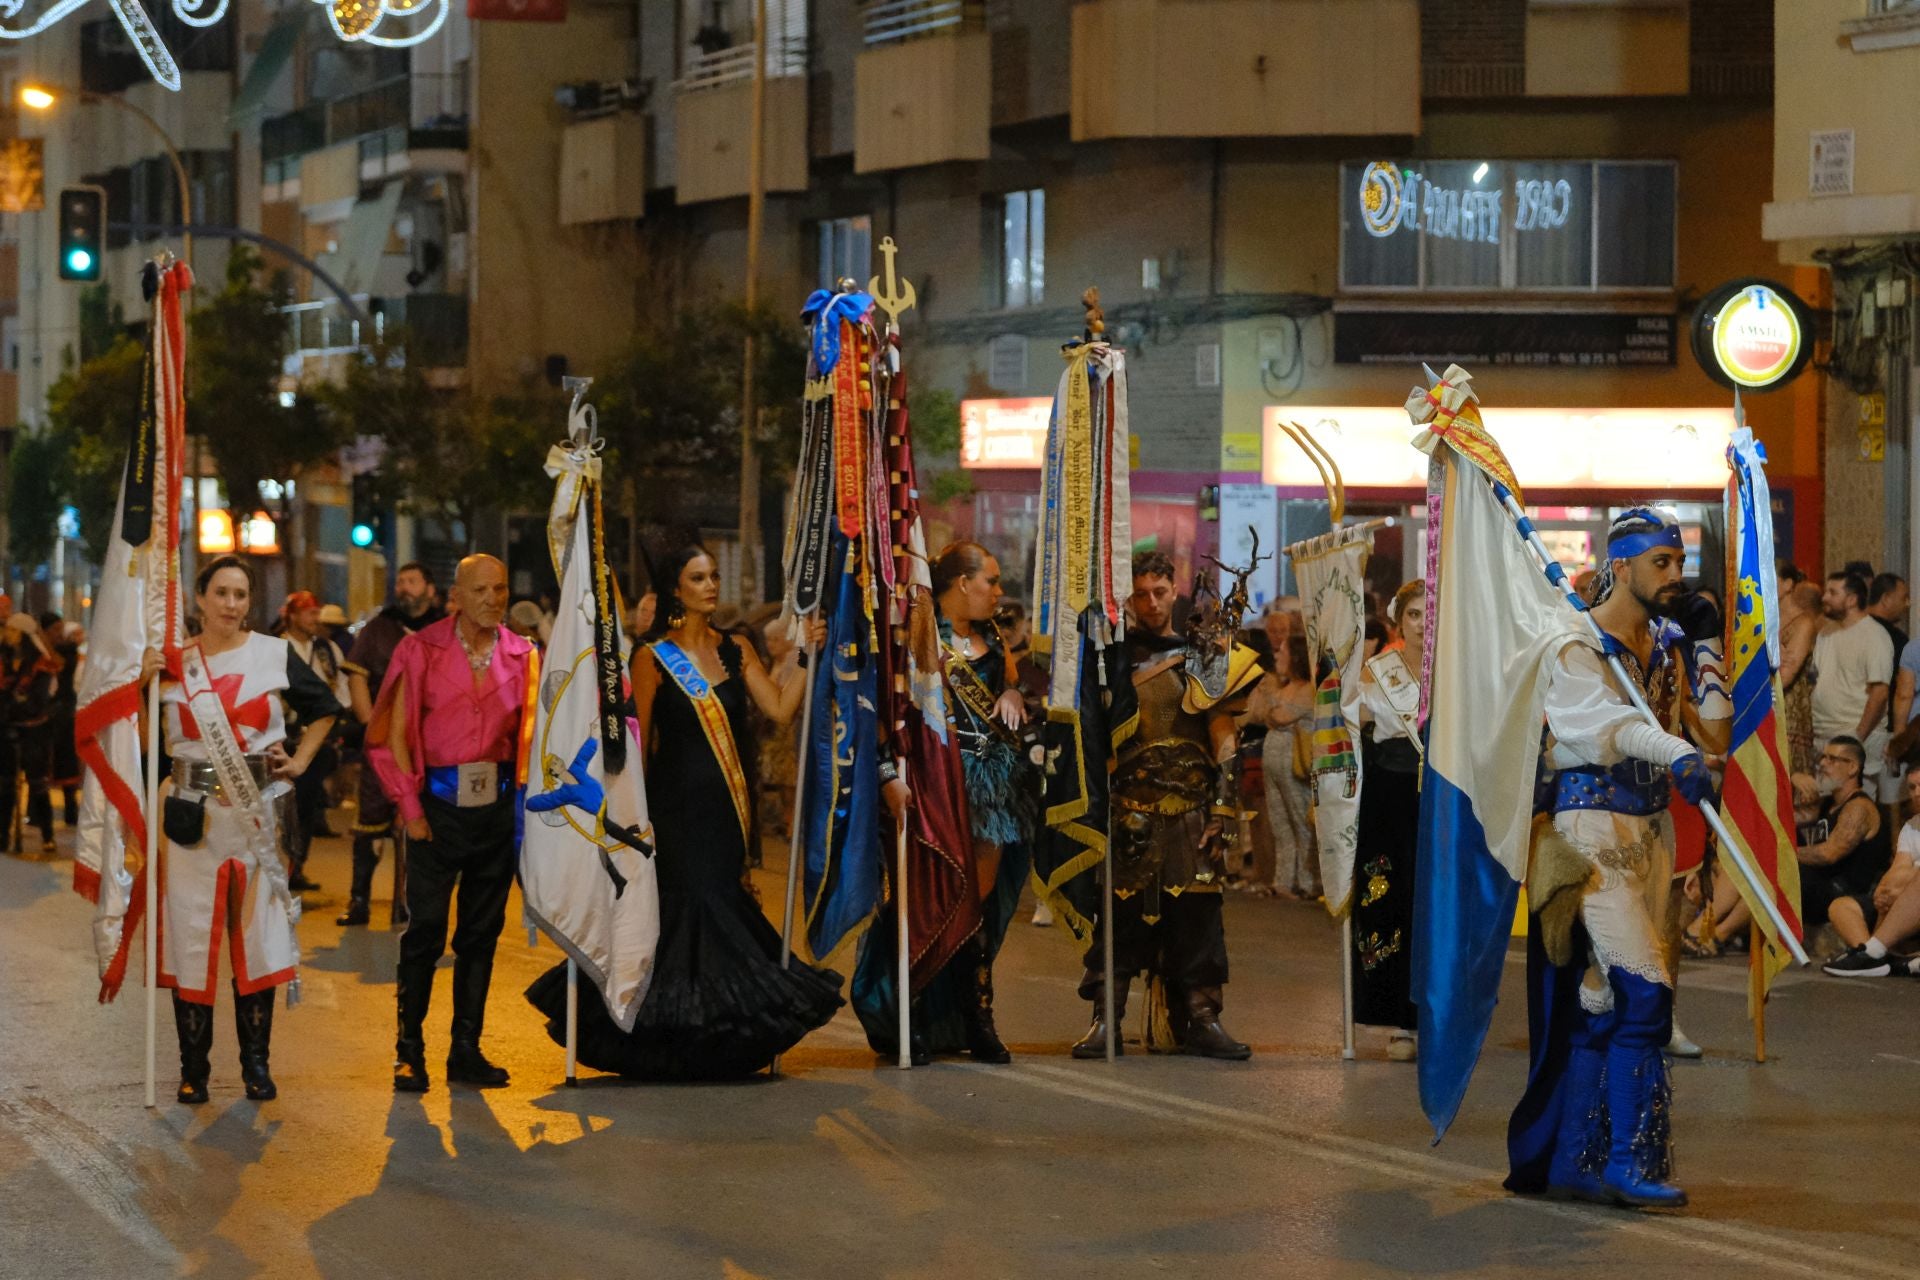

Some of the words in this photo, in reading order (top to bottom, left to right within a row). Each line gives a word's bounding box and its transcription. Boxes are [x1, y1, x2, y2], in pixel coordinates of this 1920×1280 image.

[844, 465, 855, 497] 2010
[1072, 440, 1083, 513] Abanderado
[807, 527, 820, 551] 1952
[803, 558, 815, 584] 2017
[1075, 566, 1085, 595] 2016
